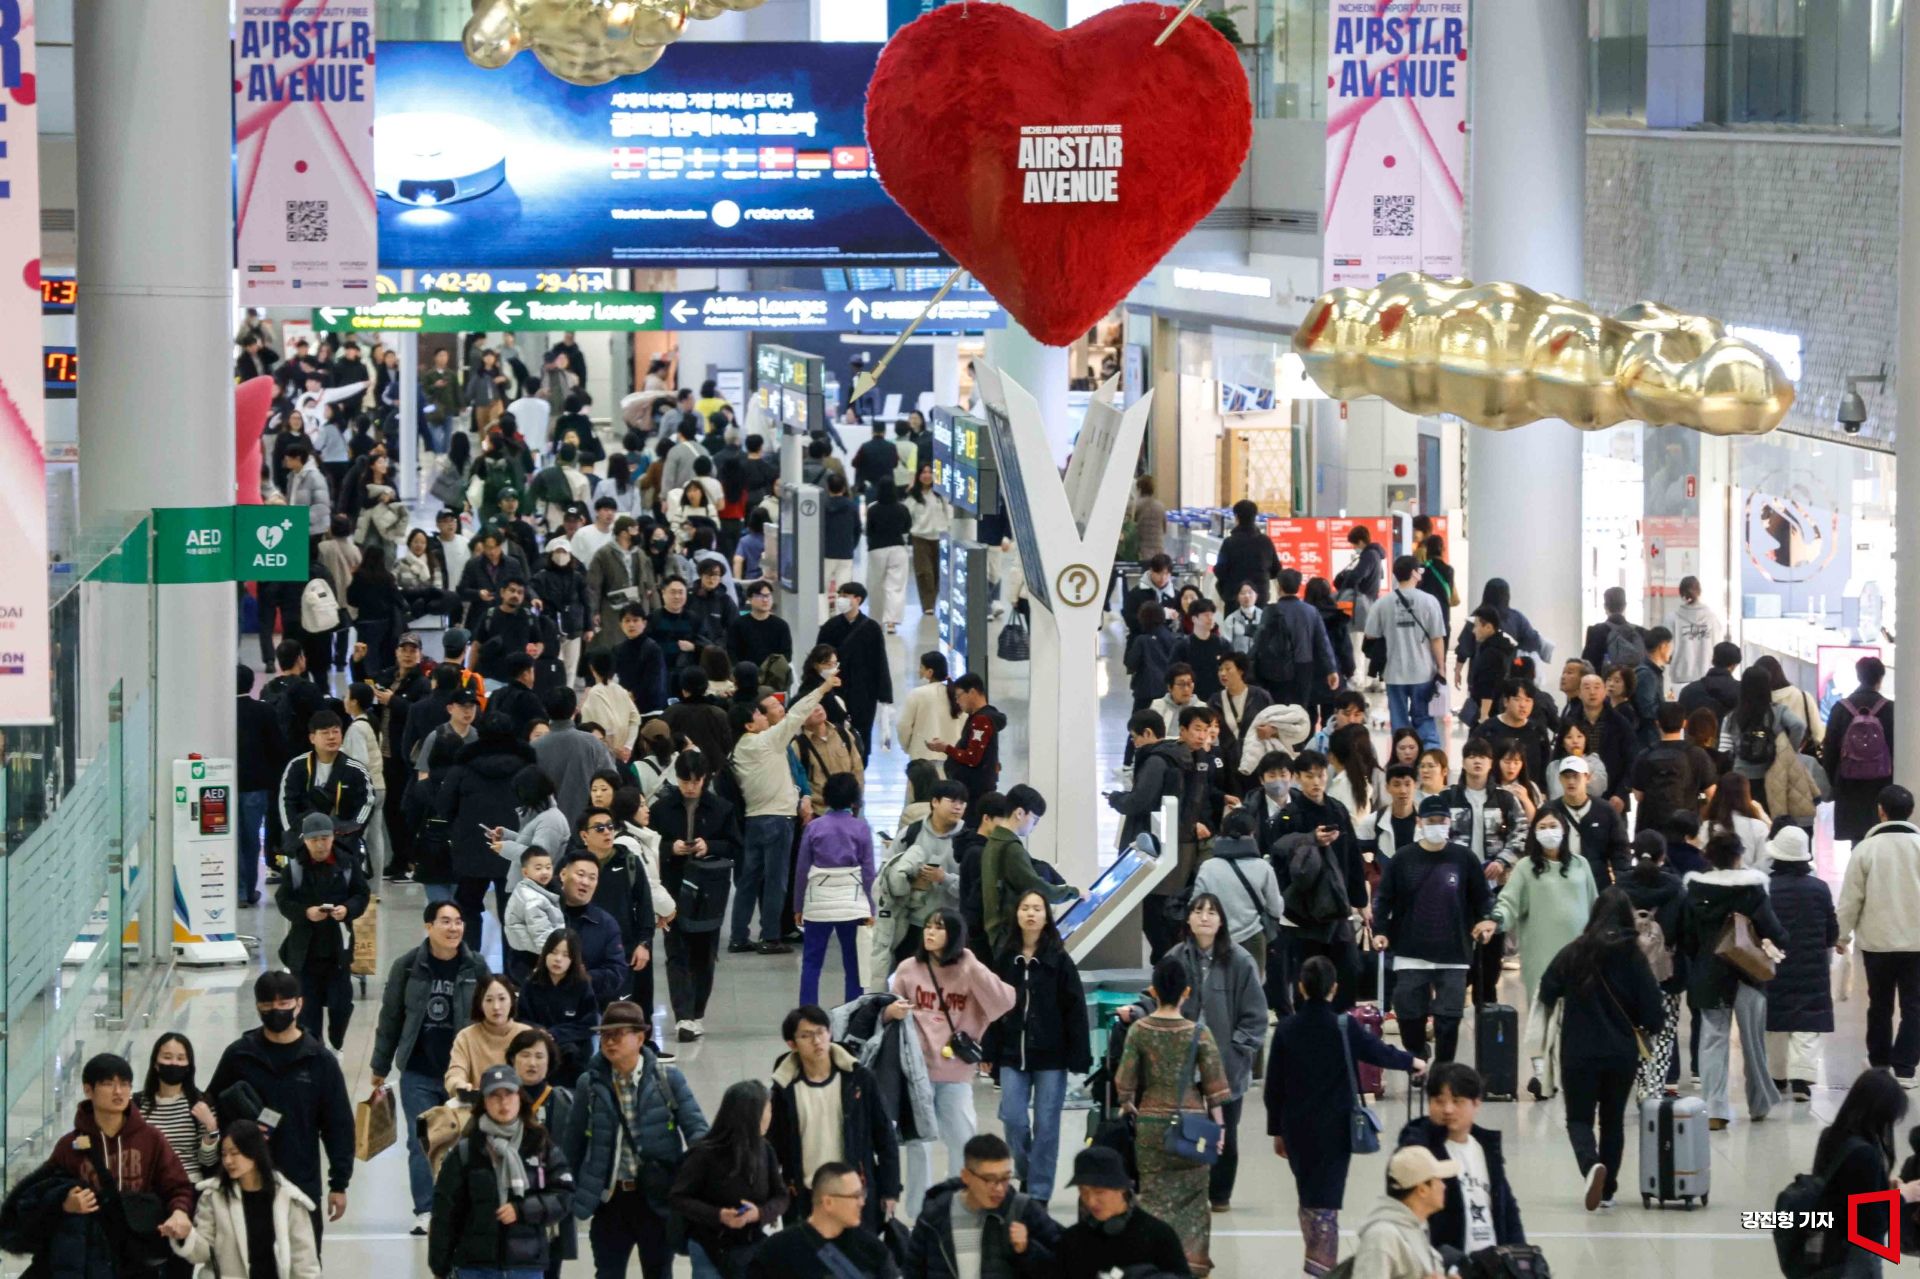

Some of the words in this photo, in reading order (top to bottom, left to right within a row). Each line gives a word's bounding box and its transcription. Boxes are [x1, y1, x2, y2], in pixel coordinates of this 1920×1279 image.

[243, 7, 281, 17] INCHEON
[322, 7, 345, 17] DUTY
[347, 7, 369, 17] FREE
[1338, 3, 1375, 13] INCHEON
[1379, 3, 1413, 13] AIRPORT
[1417, 3, 1438, 13] DUTY
[1441, 3, 1462, 13] FREE
[241, 20, 369, 58] AIRSTAR
[1334, 17, 1463, 55] AIRSTAR
[247, 63, 365, 101] AVENUE
[1339, 60, 1455, 97] AVENUE
[1020, 126, 1053, 135] INCHEON
[1053, 125, 1083, 134] AIRPORT
[1083, 125, 1103, 134] DUTY
[1103, 124, 1122, 133] FREE
[1018, 135, 1123, 169] AIRSTAR
[1023, 170, 1119, 203] AVENUE
[744, 208, 814, 220] roborock
[435, 272, 491, 292] 42-50
[536, 272, 588, 292] 29-41
[427, 297, 471, 316] Desk
[526, 300, 593, 320] Transfer
[594, 301, 656, 324] Lounge
[703, 296, 759, 314] Airline
[760, 297, 828, 319] Lounges
[185, 529, 222, 546] AED
[252, 553, 288, 567] AED
[203, 788, 226, 799] AED
